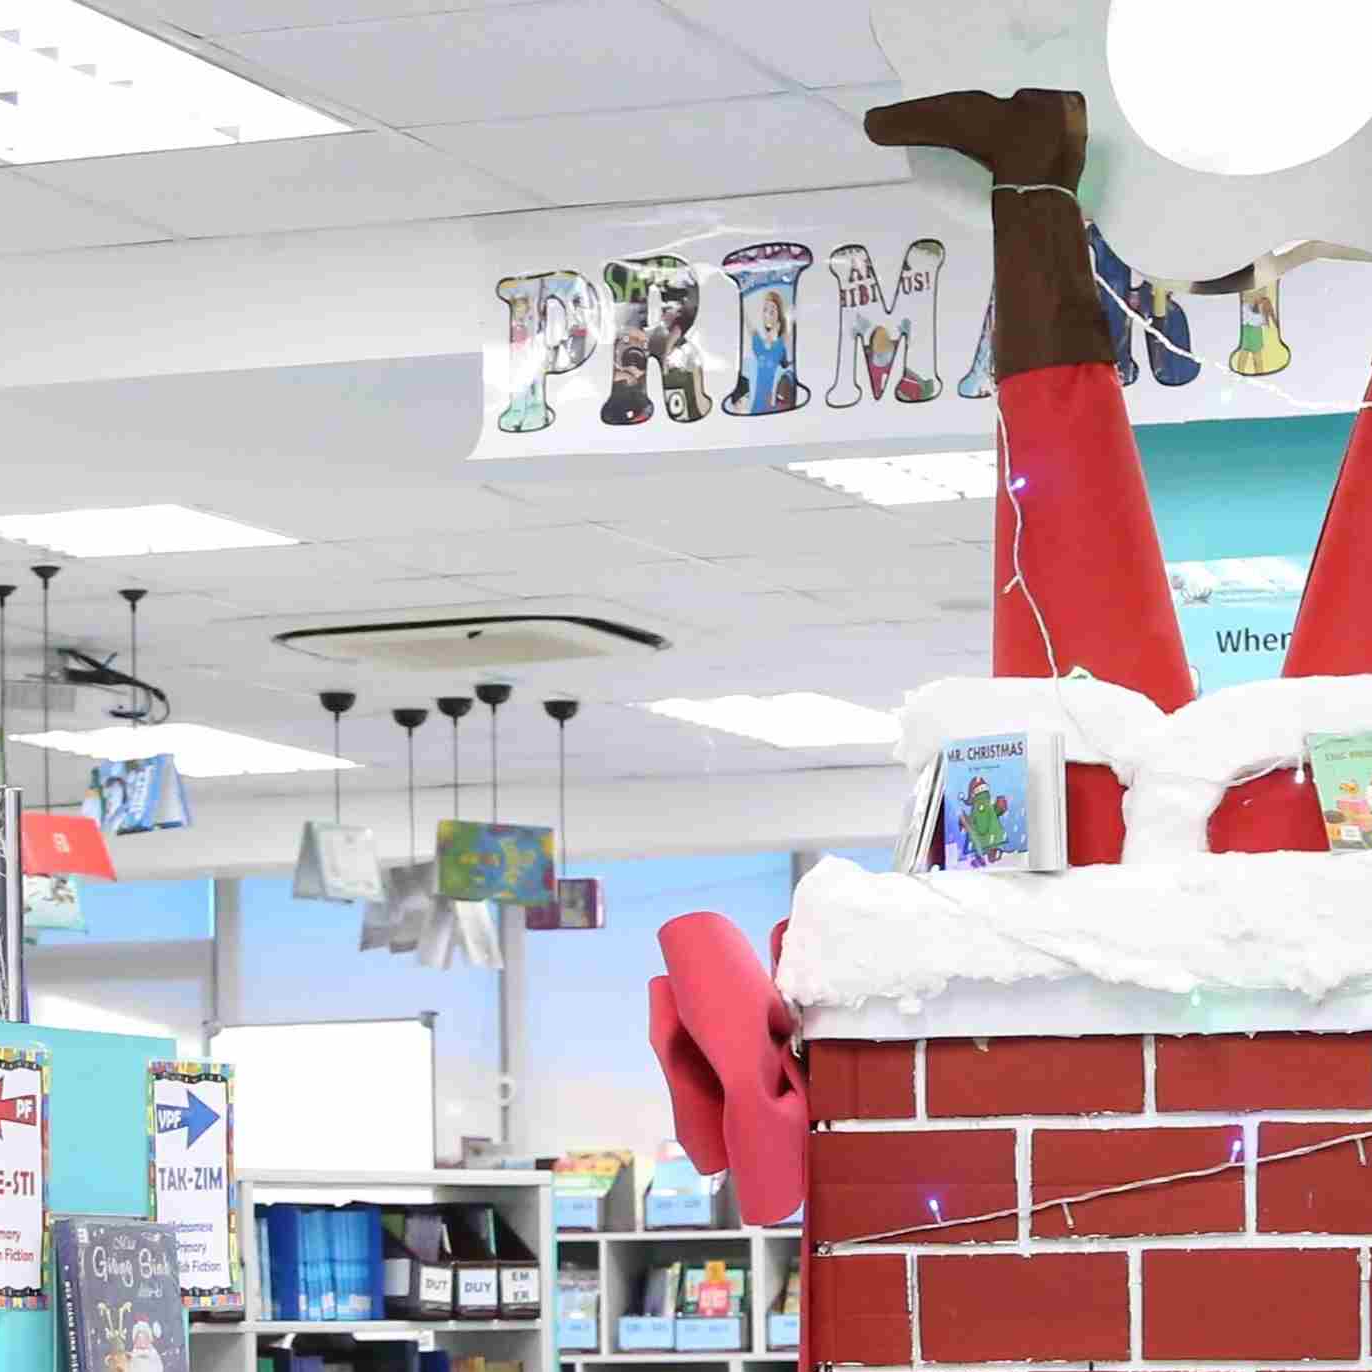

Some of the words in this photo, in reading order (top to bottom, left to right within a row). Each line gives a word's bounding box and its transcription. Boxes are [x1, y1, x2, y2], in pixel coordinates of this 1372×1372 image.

[967, 741, 1024, 761] CHRISTMAS
[15, 1099, 33, 1120] PF
[157, 1110, 182, 1129] VPF
[157, 1167, 224, 1191] TAK-ZIM
[5, 1247, 35, 1262] Fiction
[463, 1281, 493, 1294] DUY
